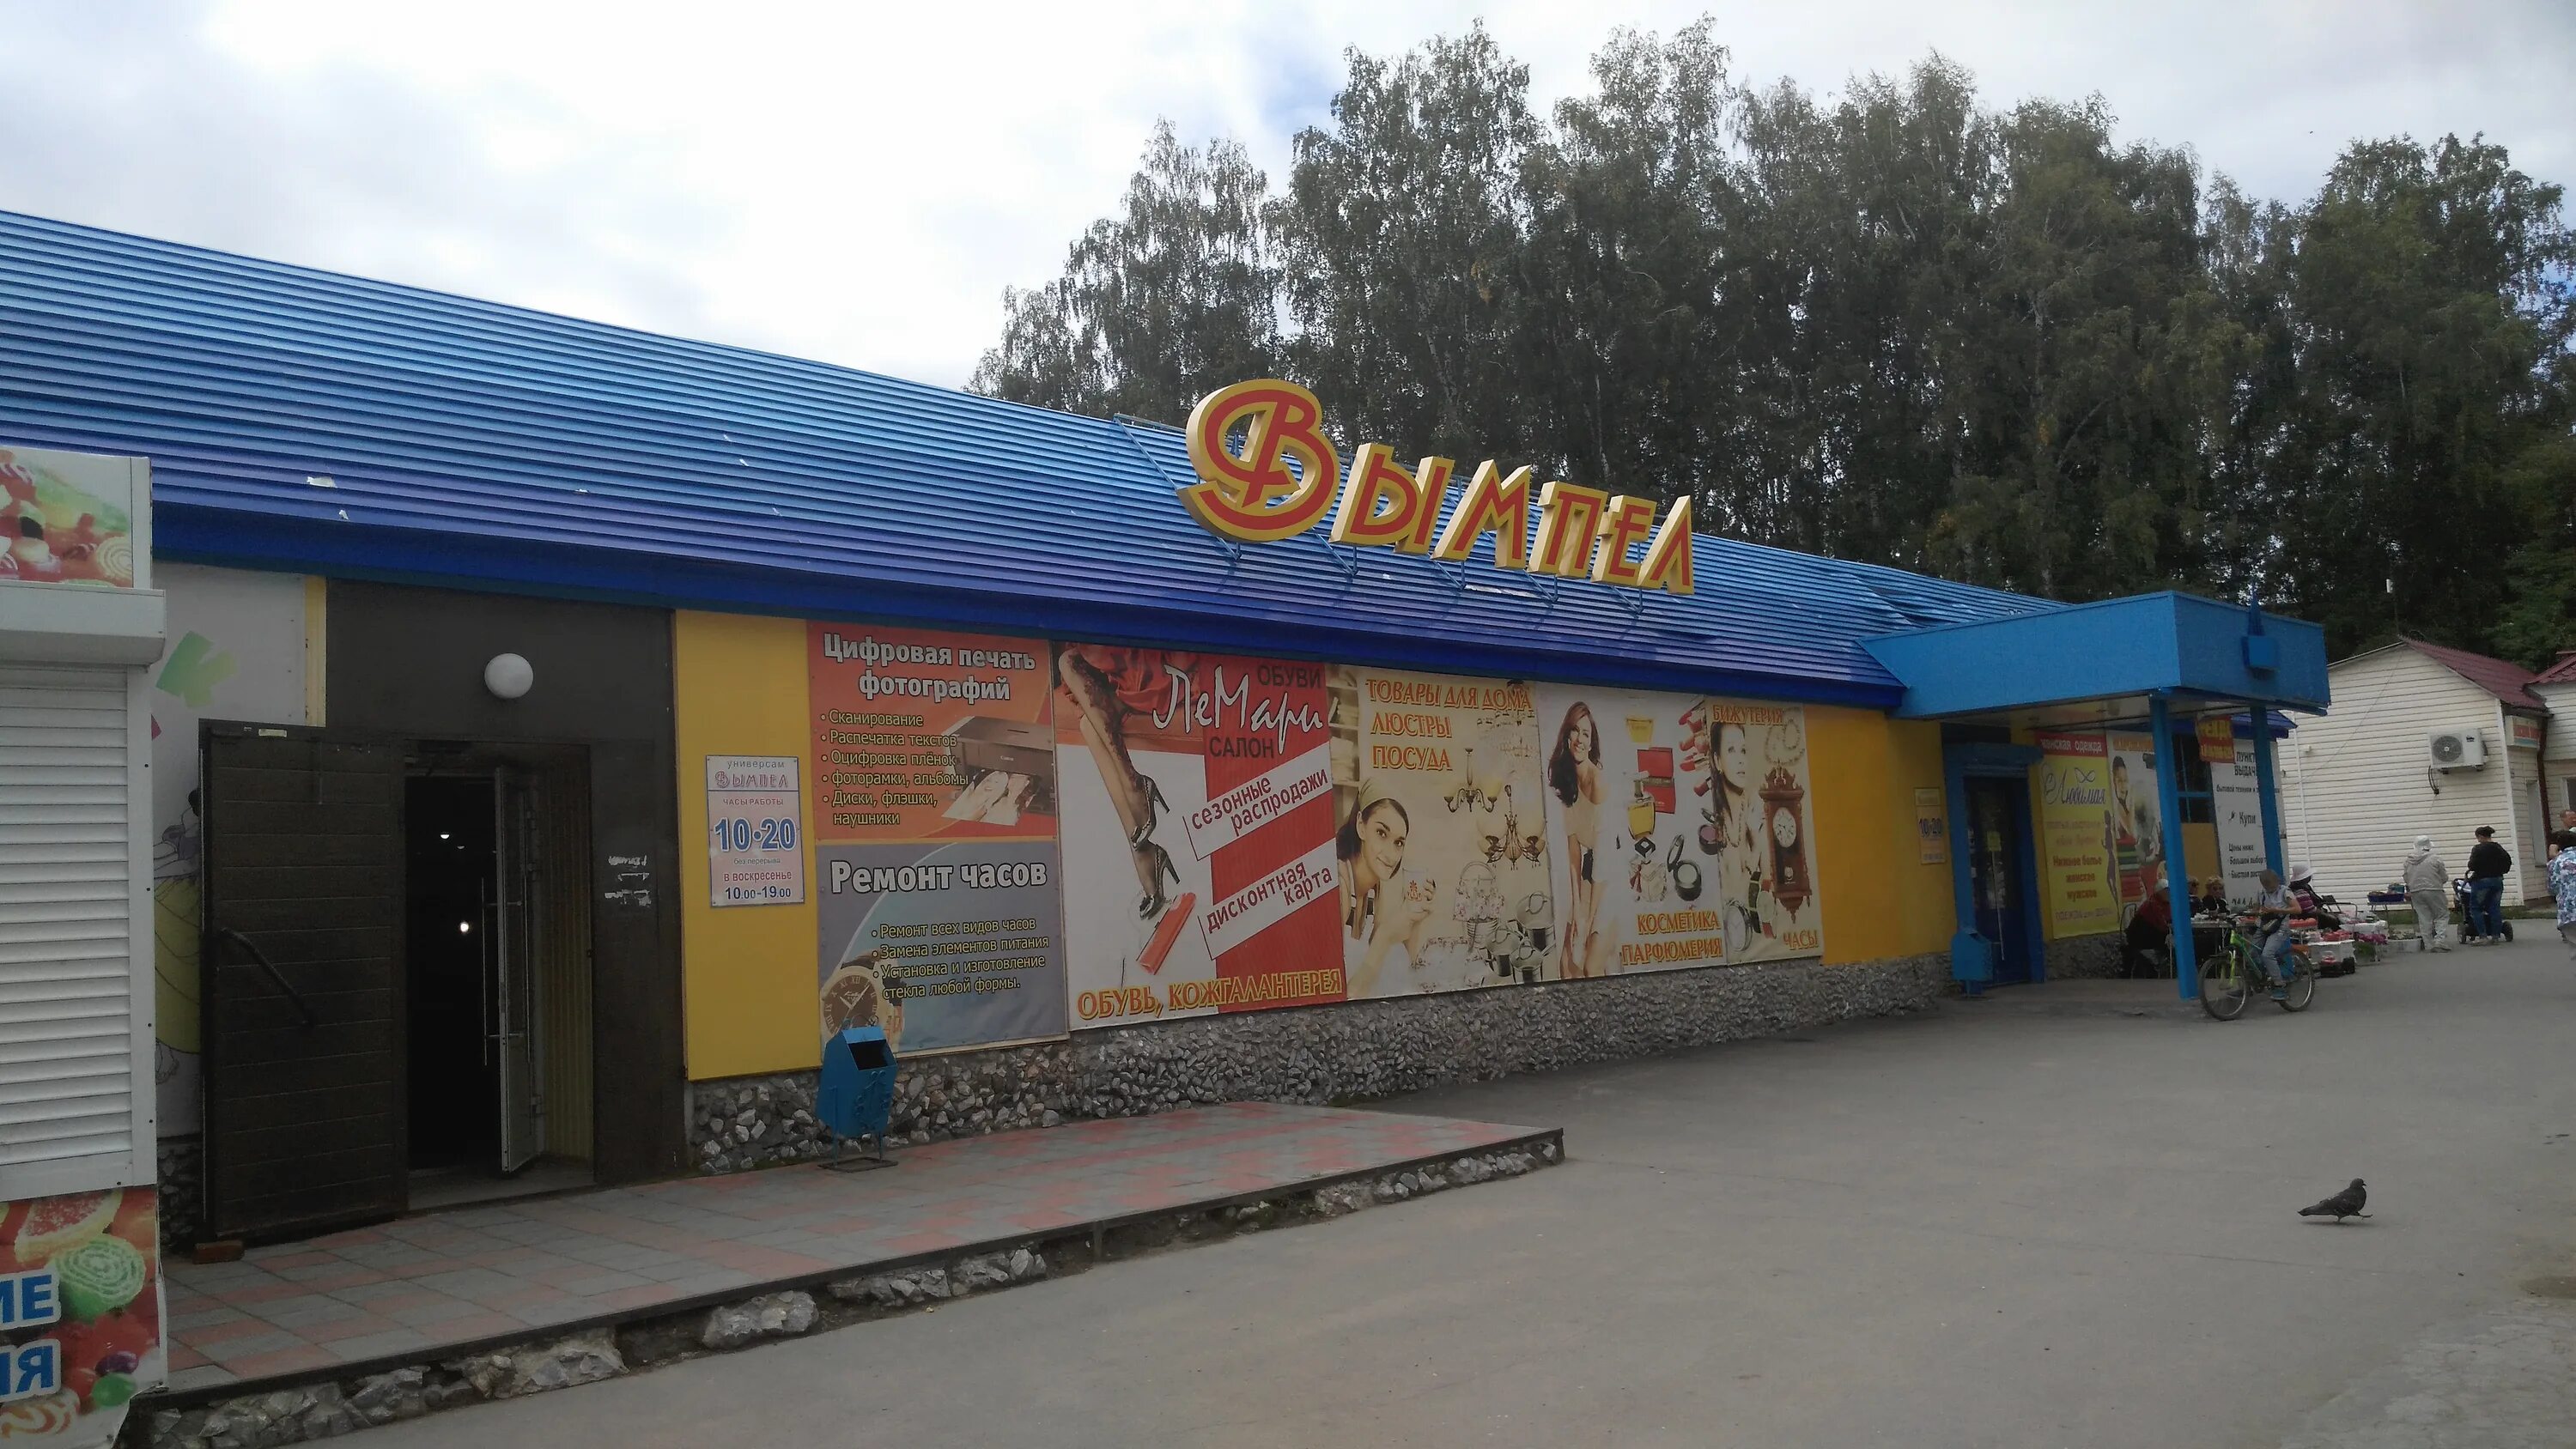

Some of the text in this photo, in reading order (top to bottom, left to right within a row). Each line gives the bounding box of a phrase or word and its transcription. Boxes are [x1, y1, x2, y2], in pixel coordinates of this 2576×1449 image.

[823, 633, 1036, 670] Цифровая печать
[859, 670, 1011, 705] фотографий
[1257, 664, 1321, 689] ОБУВИ
[1365, 679, 1534, 712] ТОВАРЫ ДЛЯ ДОМА
[829, 709, 924, 727] Сканирование
[1370, 712, 1452, 738] ЛЮСТРЫ
[1712, 705, 1785, 725] БИЖУТЕРИЯ
[829, 730, 957, 748] Распечатка текстов
[1209, 737, 1275, 758] САЛОН
[727, 760, 784, 769] универсам
[830, 750, 956, 767] Оцифровка плёнок
[1372, 746, 1453, 771] ПОСУДА
[831, 769, 969, 787] фоторамки, альбомы
[831, 790, 939, 809] Диски, флэшки,
[1191, 777, 1271, 829] сезонные
[1230, 769, 1328, 837] распродажи
[833, 812, 900, 827] наушники
[724, 870, 792, 883] в воскресенье
[830, 860, 1048, 894] Ремонт часов
[1285, 867, 1332, 906] карта
[1207, 861, 1306, 934] дисконтная
[880, 918, 1036, 939] Ремонт всех видов часов
[1637, 911, 1721, 935] КОСМЕТИКА
[880, 937, 1049, 960] Замена элементов питания
[1621, 938, 1722, 966] ПАРФЮМЕРИЯ
[1783, 931, 1819, 951] ЧАСЫ
[881, 955, 1046, 979] Установка и изготовление
[883, 977, 1021, 1001] стекла любой формы.
[1077, 968, 1344, 1020] ОБУВЬ, КОЖГАЛАНТЕРЕЯ
